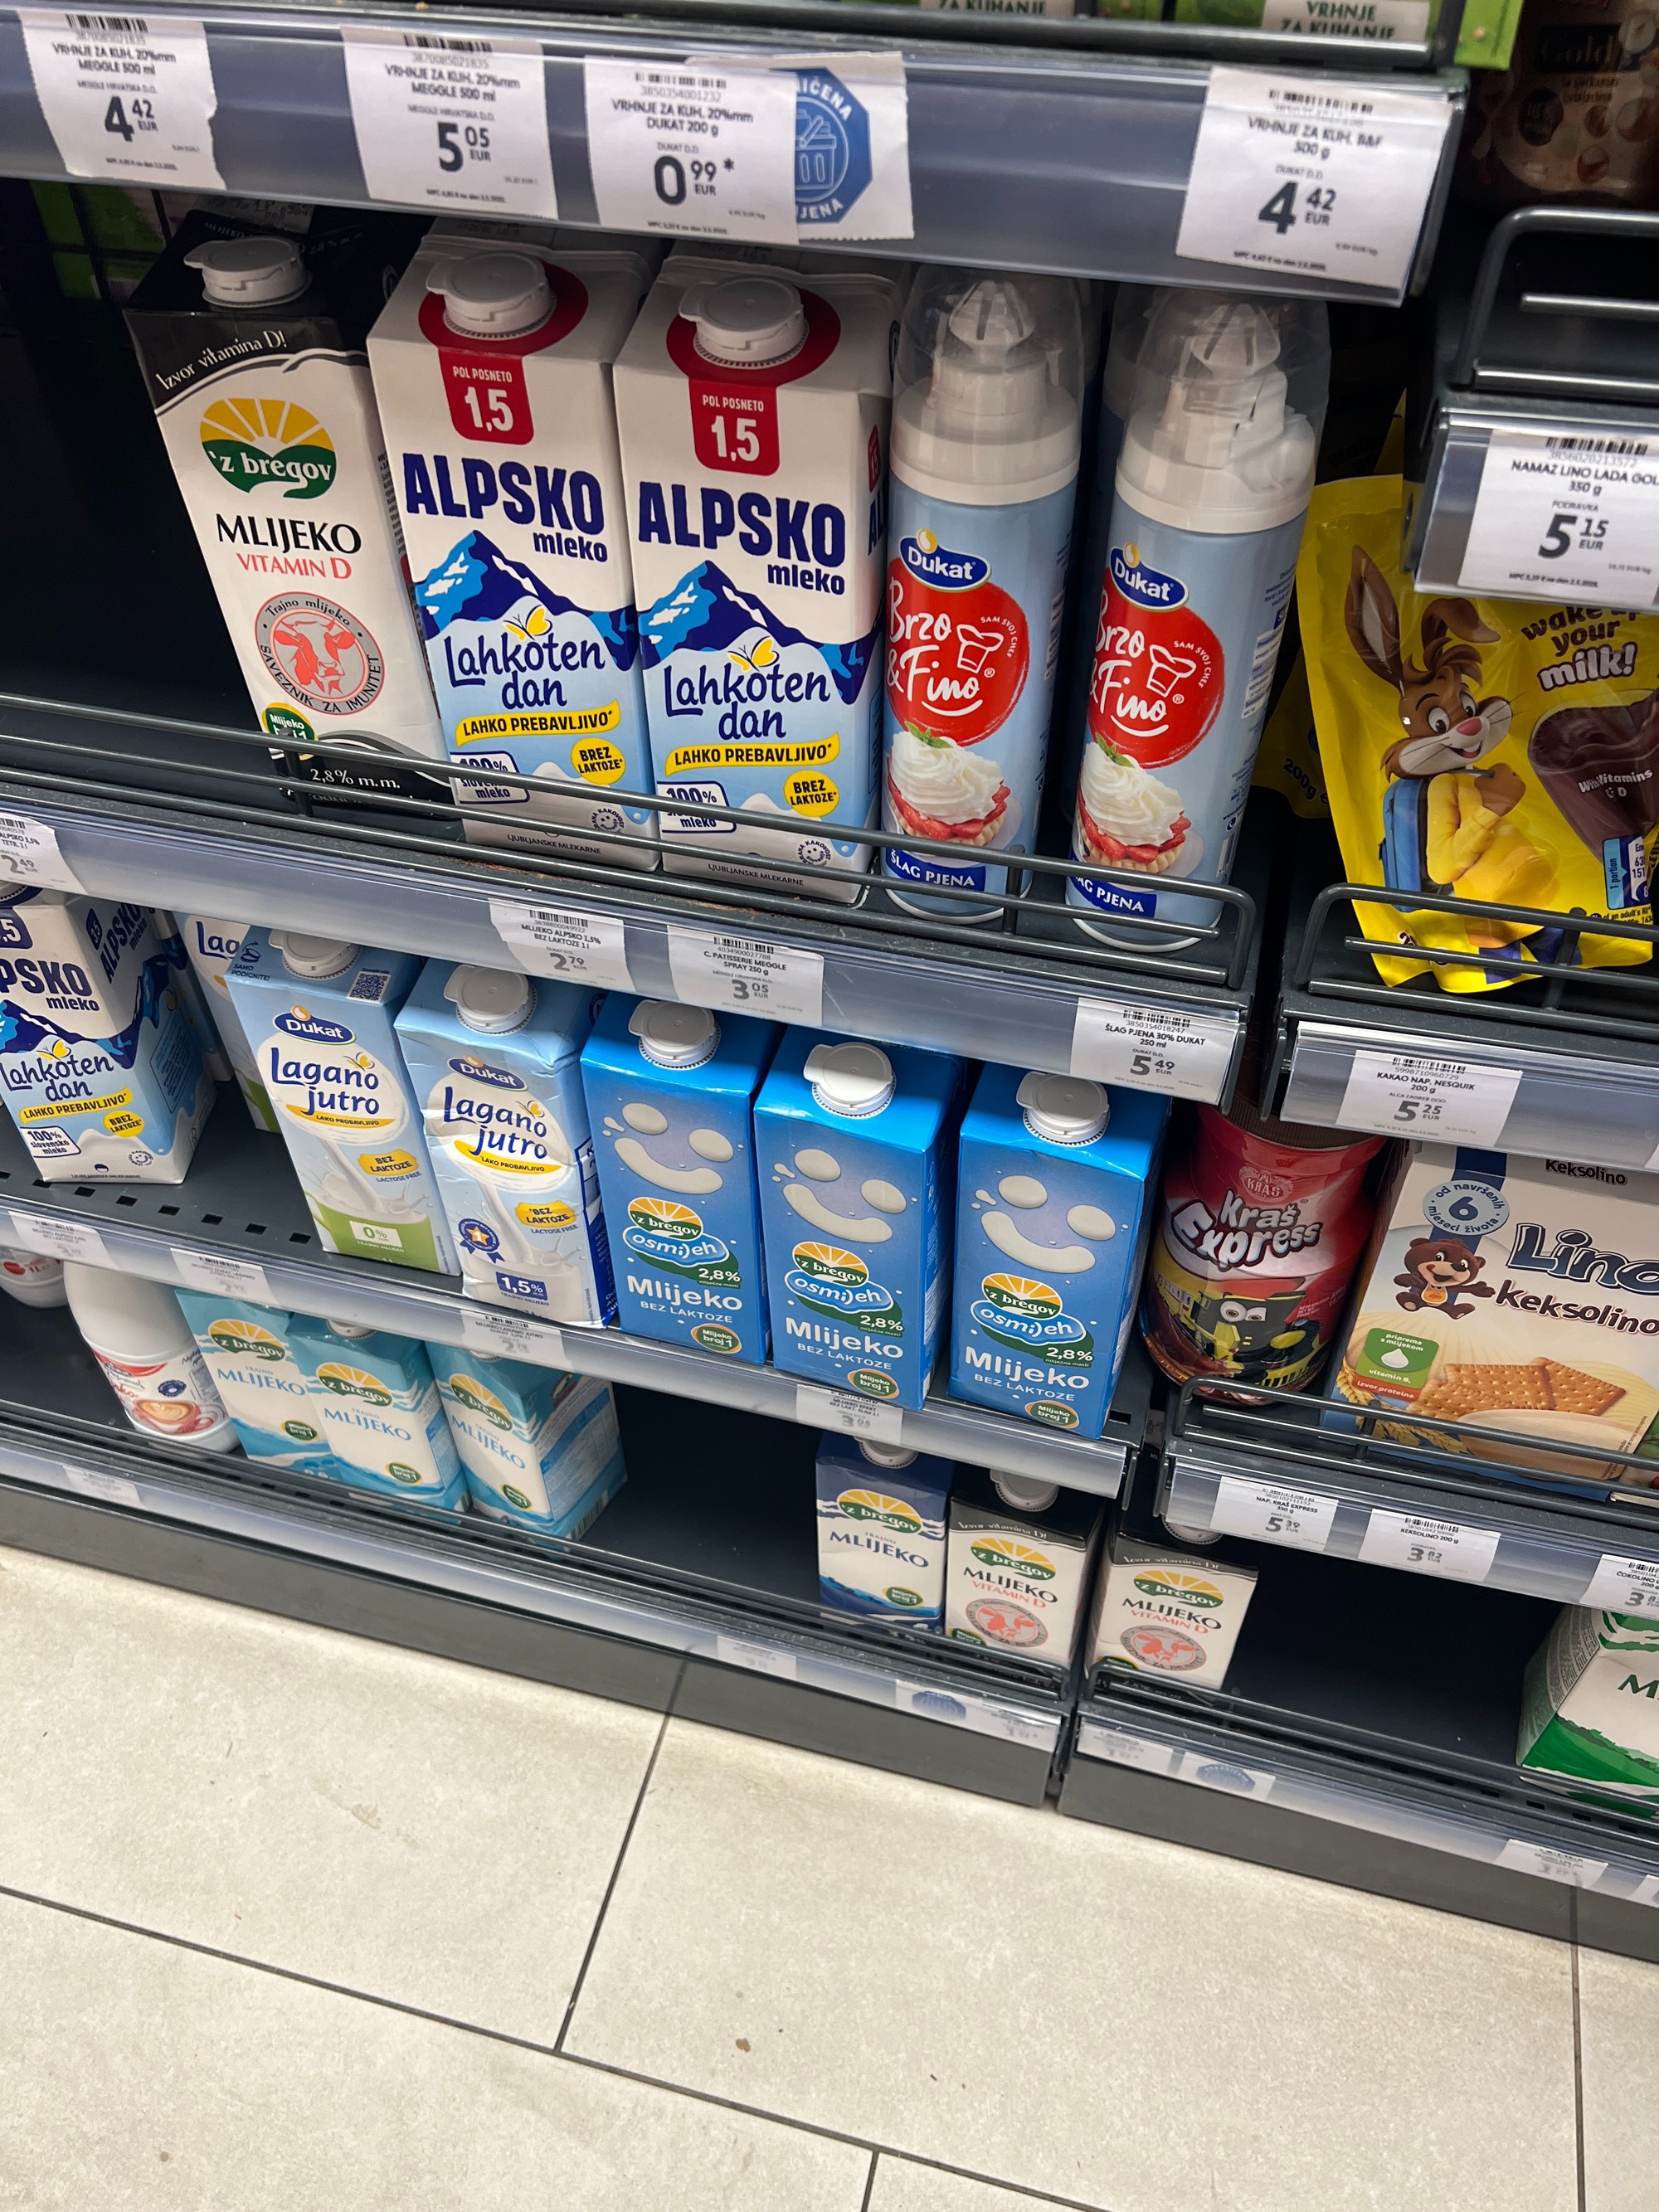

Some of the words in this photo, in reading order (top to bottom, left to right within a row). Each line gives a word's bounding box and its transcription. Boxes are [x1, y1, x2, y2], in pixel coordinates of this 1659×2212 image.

[385, 64, 427, 79] VRHNJE
[411, 82, 457, 97] MEGGLE
[105, 95, 134, 143] 4
[133, 100, 155, 119] 42
[612, 100, 657, 114] VRHNJE
[659, 104, 674, 115] ZA
[678, 105, 705, 118] KUH.
[465, 126, 490, 148] 05
[647, 119, 684, 131] DUKAT
[688, 123, 708, 134] 200
[1248, 117, 1298, 137] VRHNJE
[437, 121, 464, 173] 5
[470, 149, 491, 162] EUR
[654, 155, 685, 207] 0
[691, 161, 717, 182] 99
[695, 184, 716, 197] EUR
[1306, 188, 1336, 211] 42
[1258, 182, 1298, 236] 4
[1304, 212, 1330, 226] EUR
[155, 363, 197, 391] Izvor
[198, 337, 264, 369] vitamina
[453, 366, 471, 379] POL
[472, 368, 512, 383] POSNETO
[465, 386, 513, 433] 1,5
[703, 395, 720, 408] POL
[722, 397, 764, 411] POSNETO
[711, 416, 760, 462] 1,5
[243, 452, 332, 482] bregov
[1512, 461, 1557, 474] NAMAZ
[1560, 466, 1591, 479] LINO
[1594, 469, 1627, 483] LADA
[402, 453, 605, 535] ALPSKO
[1569, 482, 1589, 493] 350
[1552, 500, 1598, 513] PODRAVKA
[216, 513, 362, 554] MLIJEKO
[639, 481, 845, 567] ALPSKO
[1580, 518, 1609, 538] 15
[533, 532, 608, 563] mleko
[1537, 513, 1578, 560] 5
[1579, 540, 1603, 551] EUR
[236, 553, 327, 578] VITAMIN
[330, 557, 352, 579] D
[908, 546, 974, 580] Dukat
[768, 564, 845, 596] mleko
[1115, 557, 1170, 601] Dukat
[265, 599, 299, 617] Trajno
[305, 599, 350, 626] mlijeko
[888, 576, 952, 644] Brzo
[980, 615, 1000, 624] SAM
[1001, 618, 1017, 635] SVOJ
[1007, 636, 1017, 658] CHEF
[1550, 620, 1620, 657] your
[444, 632, 606, 688] Lahkoten
[1540, 644, 1636, 689] milk!
[260, 644, 314, 707] SAVEZNIK
[348, 654, 380, 711] IMUNITET
[899, 644, 980, 702] Fino
[502, 670, 567, 710] dan
[664, 663, 830, 717] Lahkoten
[1098, 659, 1166, 722] Fino
[463, 718, 507, 737] LAHKO
[718, 701, 786, 740] dan
[579, 746, 612, 761] BREZ
[675, 747, 721, 766] LAHKO
[310, 768, 354, 785] 2,8%
[358, 776, 400, 789] m.m.
[1597, 769, 1652, 788] Vitamins
[507, 834, 557, 848] LJUBLJANSKE
[558, 842, 601, 854] MLEKARNE
[891, 848, 921, 878] ŠLAG
[926, 873, 975, 887] PJENA
[1609, 858, 1621, 885] portion
[522, 924, 553, 935] MLIJEKO
[554, 931, 582, 941] ALPSKO
[548, 936, 580, 947] LAKTOZE
[549, 953, 571, 971] 2
[713, 953, 753, 965] PATISSERIE
[754, 960, 786, 970] MEGGLE
[724, 961, 747, 970] SPRAY
[0, 958, 93, 996] PSKO
[732, 980, 750, 1000] 3
[752, 984, 769, 993] 05
[46, 996, 100, 1011] mleko
[285, 1018, 343, 1038] Dukat
[1105, 1023, 1127, 1034] ŠLAG
[1128, 1028, 1155, 1039] PJENA
[1176, 1036, 1205, 1046] DUKAT
[1126, 1019, 1185, 1033] 3850354018247
[1140, 1038, 1155, 1047] 250
[0, 1054, 114, 1091] Lahkoten
[270, 1048, 379, 1090] Lagano
[1130, 1054, 1151, 1076] 5
[1155, 1059, 1175, 1070] 49
[45, 1079, 93, 1101] dan
[1377, 1072, 1408, 1082] KAKAO
[1434, 1079, 1476, 1090] NESQUIK
[300, 1086, 380, 1116] jutro
[444, 1086, 547, 1138] Lagano
[1394, 1101, 1420, 1121] 5
[1423, 1104, 1442, 1115] 25
[467, 1125, 547, 1159] jutro
[370, 1161, 412, 1172] LAKTOZE
[375, 1156, 395, 1164] BEZ
[1545, 1159, 1626, 1186] Keksolino
[1453, 1182, 1505, 1209] navršenih
[1220, 1189, 1299, 1229] Kraš
[1428, 1205, 1460, 1232] mjeseci
[1464, 1217, 1500, 1234] života
[1449, 1196, 1478, 1222] 6
[649, 1218, 699, 1237] bregov
[1173, 1202, 1323, 1270] Express
[632, 1234, 718, 1259] osmijeh
[1506, 1222, 1659, 1295] Lino
[499, 1276, 543, 1294] 1,5%
[698, 1268, 741, 1282] 2,8%
[627, 1276, 742, 1310] Mlijeko
[794, 1278, 883, 1305] osmijeh
[640, 1301, 667, 1312] BEZ
[670, 1307, 733, 1323] LAKTOZE
[1002, 1294, 1057, 1315] bregov
[1496, 1279, 1659, 1336] Keksolino
[234, 1339, 282, 1359] bregov
[786, 1317, 903, 1359] Mlijeko
[1386, 1339, 1423, 1352] mlijekom
[1046, 1347, 1093, 1362] 2,8%
[965, 1346, 1090, 1389] Mlijeko
[217, 1369, 306, 1397] MLIJEKO
[1006, 1380, 1075, 1402] LAKTOZE
[1357, 1380, 1377, 1391] izvor
[1378, 1386, 1414, 1399] proteina
[324, 1407, 411, 1441] MLIJEKO
[451, 1415, 526, 1469] MLIJEKO
[1291, 1505, 1318, 1513] EXPRESS
[1265, 1516, 1283, 1533] 5
[1286, 1519, 1301, 1529] 39
[1400, 1528, 1439, 1539] KEKSOLINO
[830, 1531, 929, 1568] MLIJEKO
[1407, 1547, 1424, 1562] 3
[963, 1566, 1058, 1604] MLIJEKO
[972, 1581, 1029, 1605] VITAMIN
[1155, 1585, 1218, 1607] bregov
[1122, 1598, 1222, 1630] MLIJEKO
